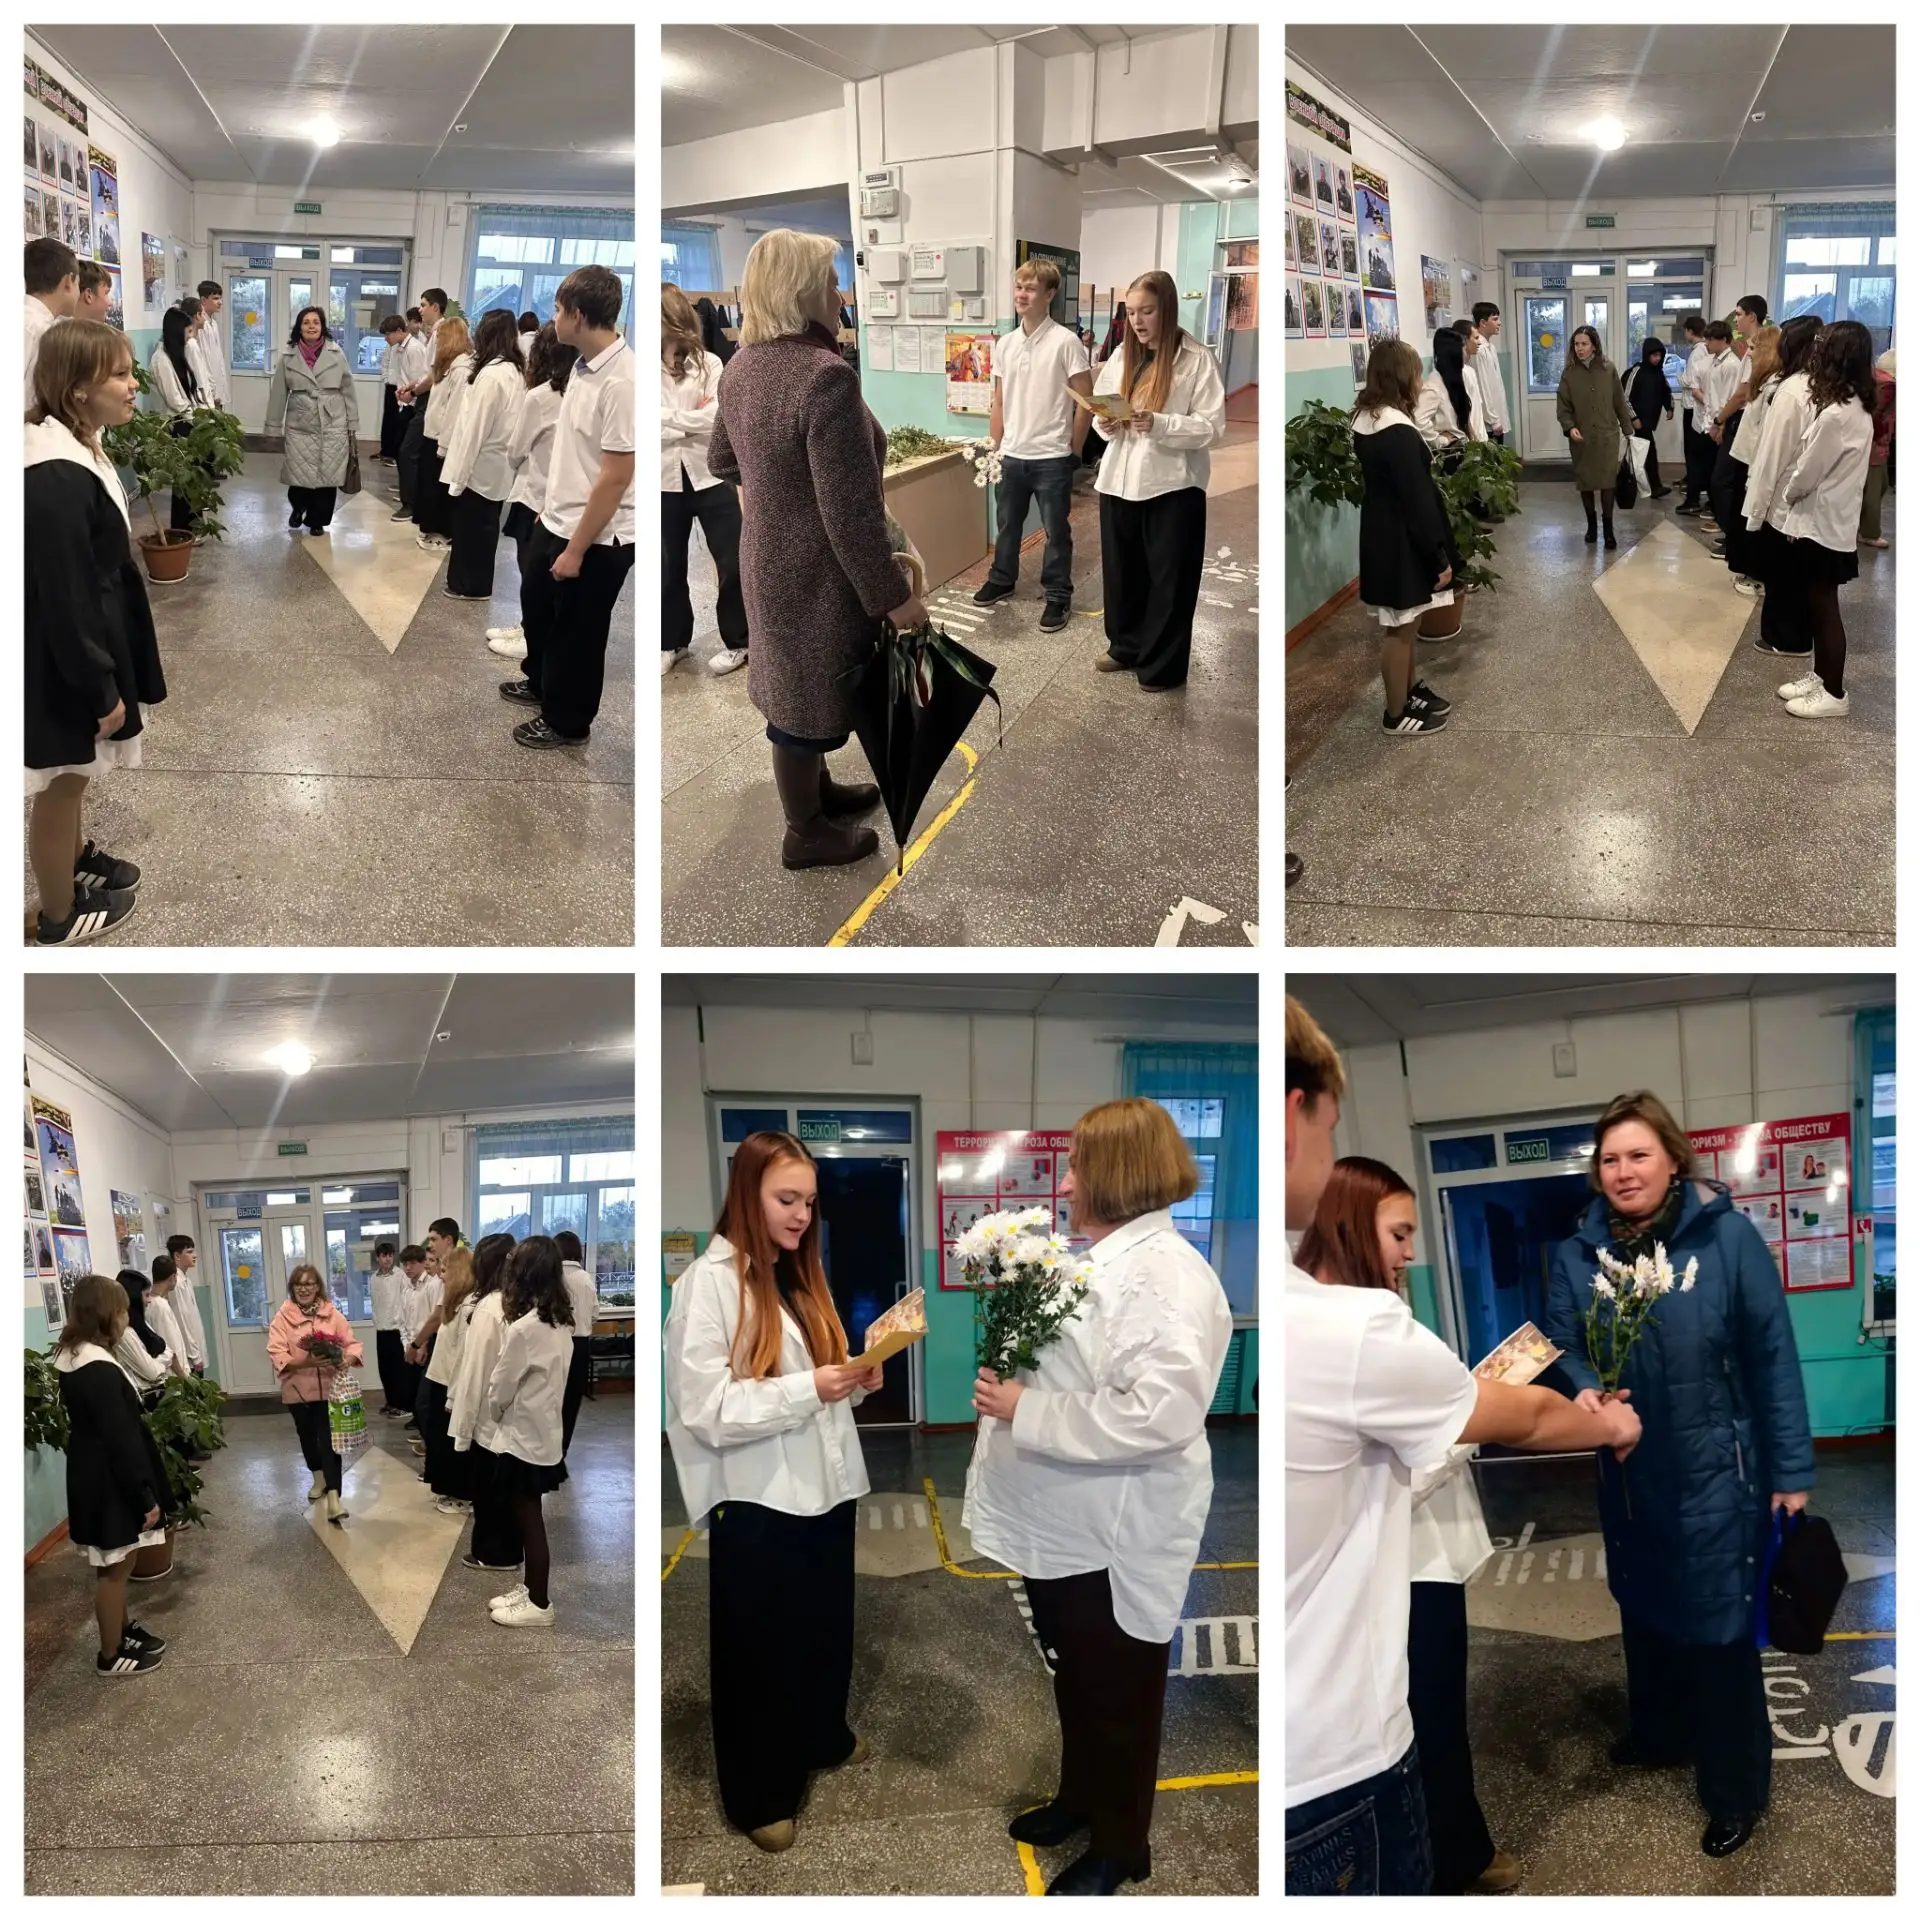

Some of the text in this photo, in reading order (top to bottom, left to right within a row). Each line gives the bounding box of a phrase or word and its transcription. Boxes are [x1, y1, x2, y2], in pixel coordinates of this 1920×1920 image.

[1543, 278, 1566, 287] ВЫХОД
[801, 1122, 838, 1139] ВЫХОД
[1689, 1133, 1726, 1150] ОРИЗМ
[1774, 1121, 1832, 1140] ОБЩЕСТВУ
[953, 1136, 999, 1149] ТЕРРОРИ
[1050, 1136, 1073, 1149] ОБЩ
[1508, 1143, 1547, 1161] ВЫХОД
